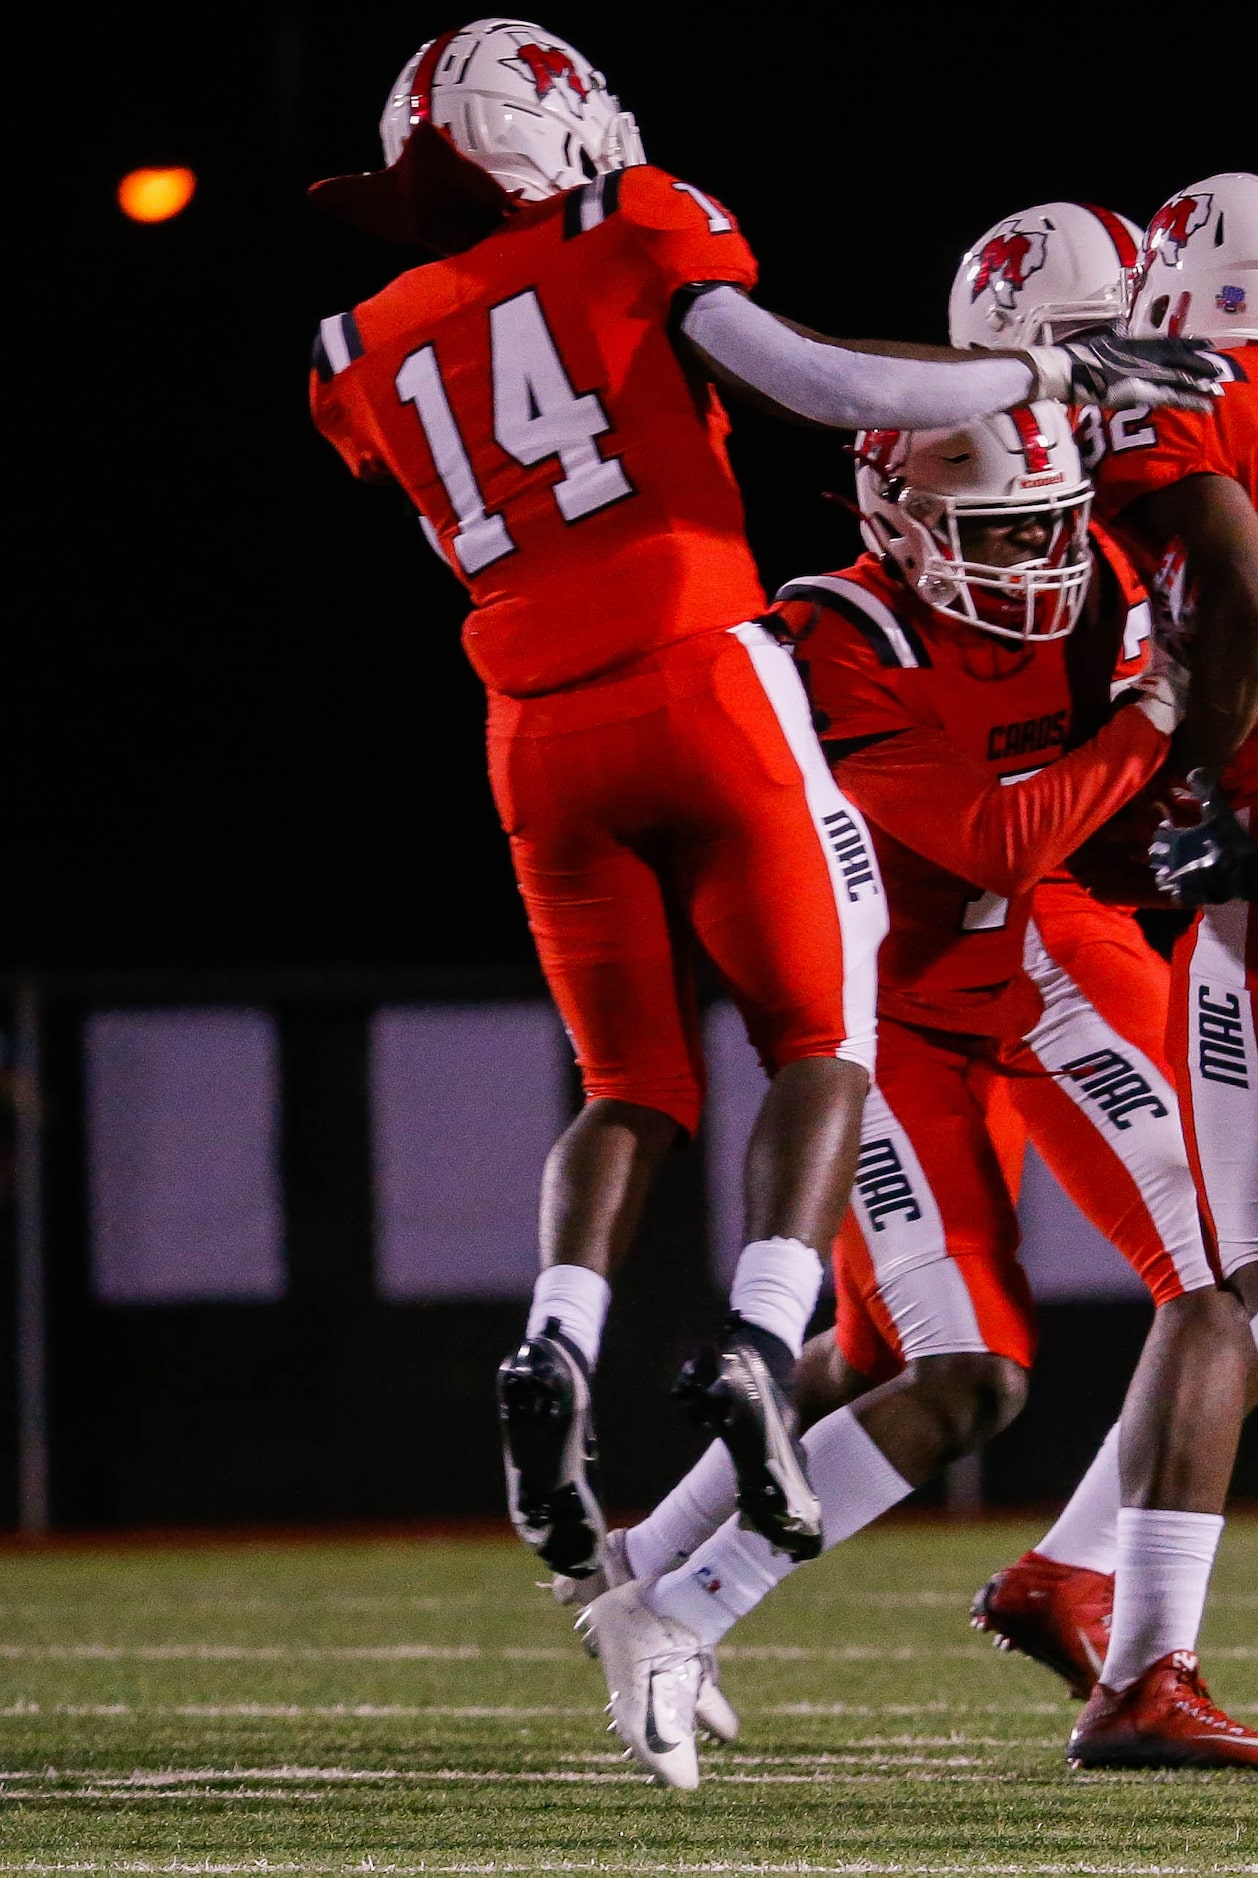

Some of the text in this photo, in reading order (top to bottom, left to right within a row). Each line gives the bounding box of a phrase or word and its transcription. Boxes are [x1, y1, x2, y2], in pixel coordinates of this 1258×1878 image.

[671, 182, 732, 233] 1
[395, 284, 637, 577] 14
[1077, 403, 1157, 469] 32
[987, 709, 1068, 760] CARDS
[823, 810, 879, 902] MAC
[1198, 984, 1251, 1090] MAC
[1060, 1048, 1169, 1130] MAC
[853, 1138, 922, 1232] MAC
